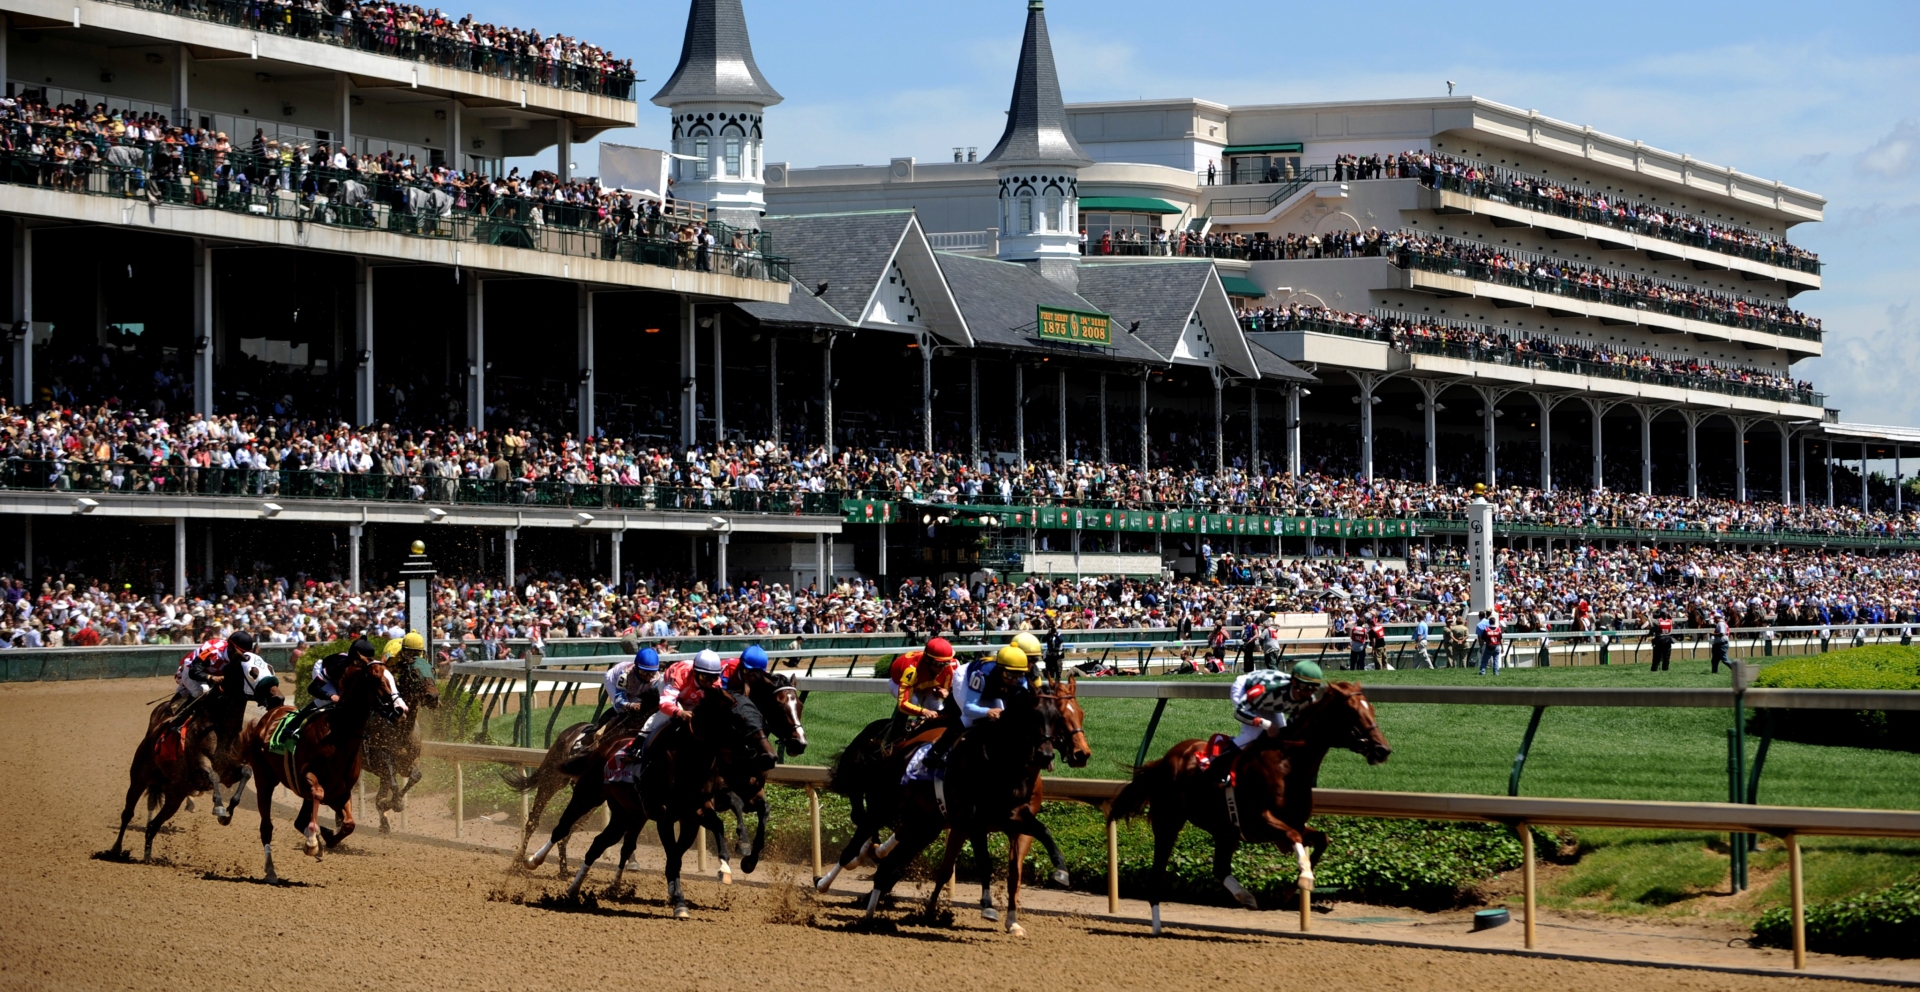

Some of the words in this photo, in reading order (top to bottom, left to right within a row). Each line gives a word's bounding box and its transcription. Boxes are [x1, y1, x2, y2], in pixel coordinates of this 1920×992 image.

[1054, 313, 1068, 323] DERBY
[1043, 321, 1066, 335] 1875
[1082, 325, 1106, 340] 2008
[617, 676, 625, 688] 2
[905, 671, 915, 682] 4
[969, 676, 981, 690] 10
